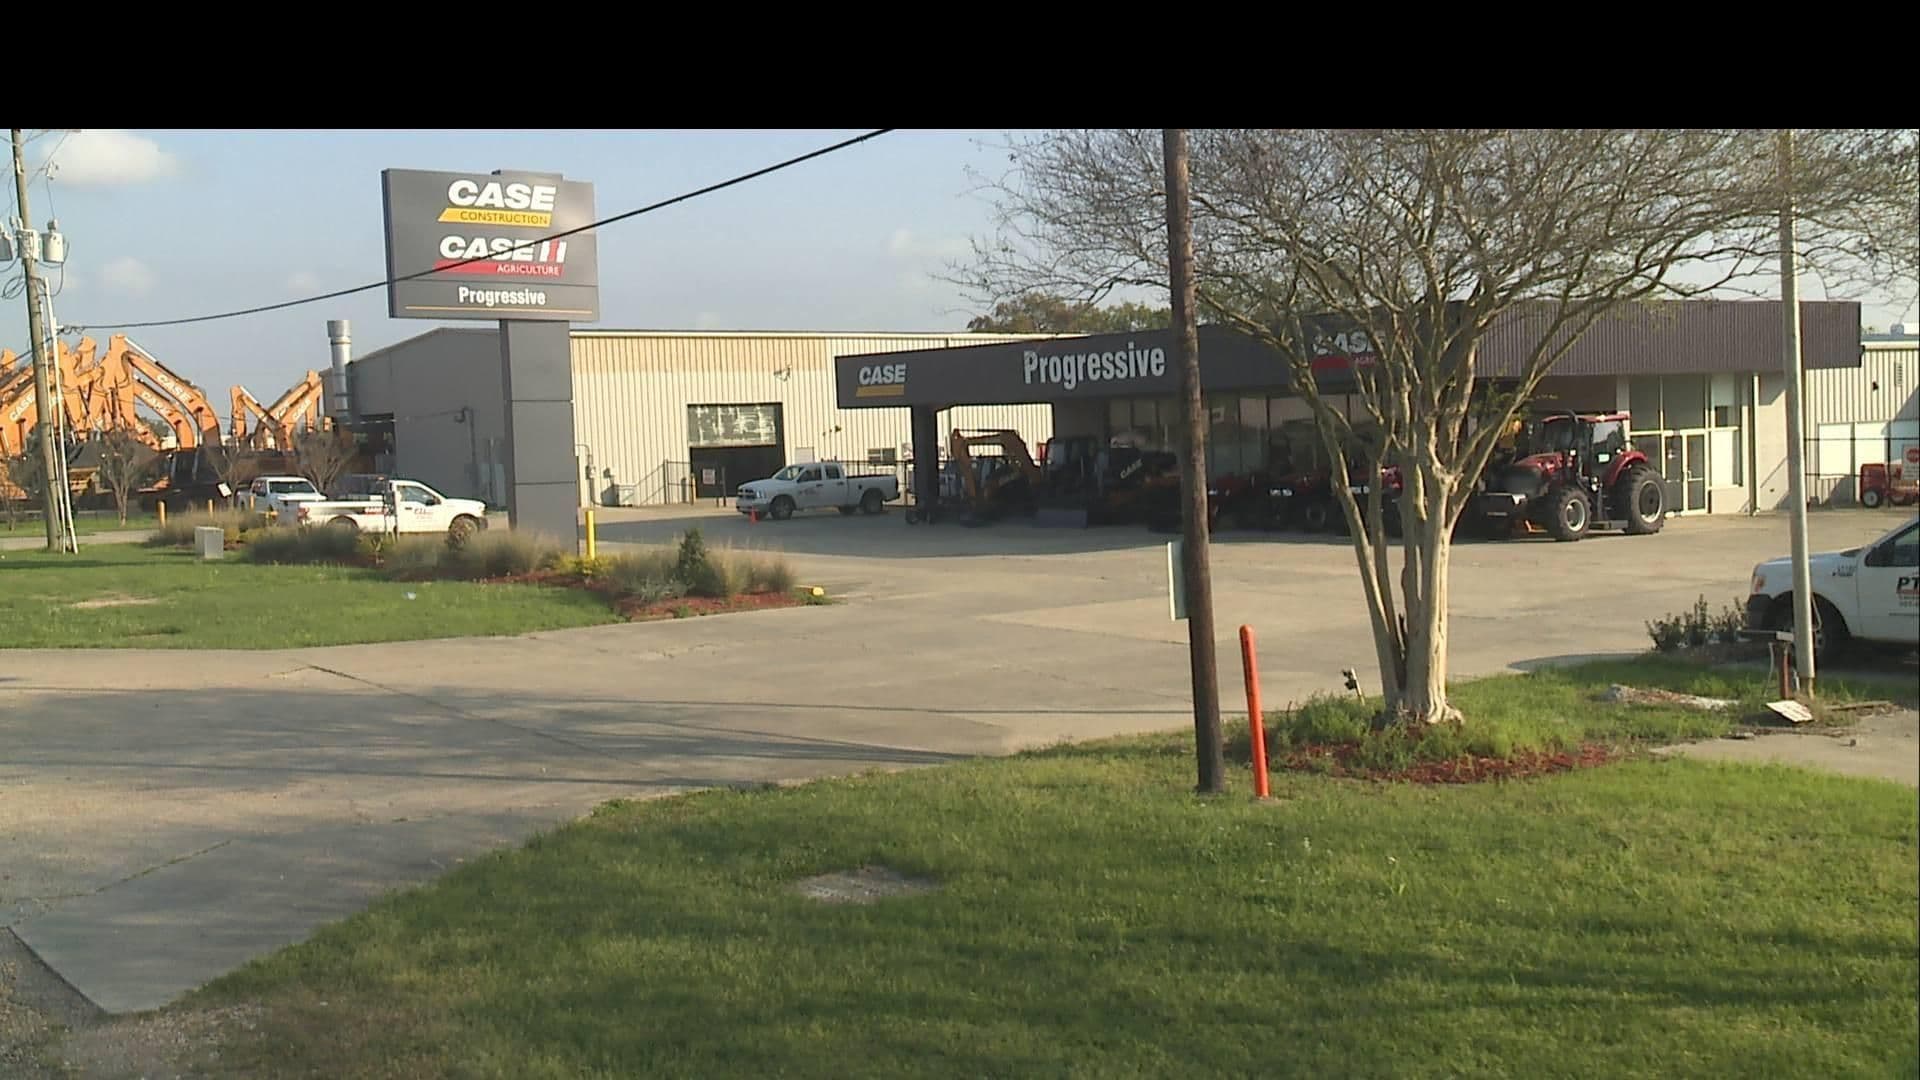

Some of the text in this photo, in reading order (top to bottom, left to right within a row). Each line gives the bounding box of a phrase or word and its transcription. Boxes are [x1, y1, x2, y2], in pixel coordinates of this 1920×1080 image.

[448, 179, 557, 210] CASE
[459, 210, 549, 225] CONSTRUCTION
[439, 235, 534, 262] CASE
[496, 262, 561, 276] AGRICULTURE
[458, 286, 546, 307] Progressive
[858, 363, 907, 386] CASE
[1022, 342, 1167, 391] Progressive
[157, 373, 191, 402] CASE
